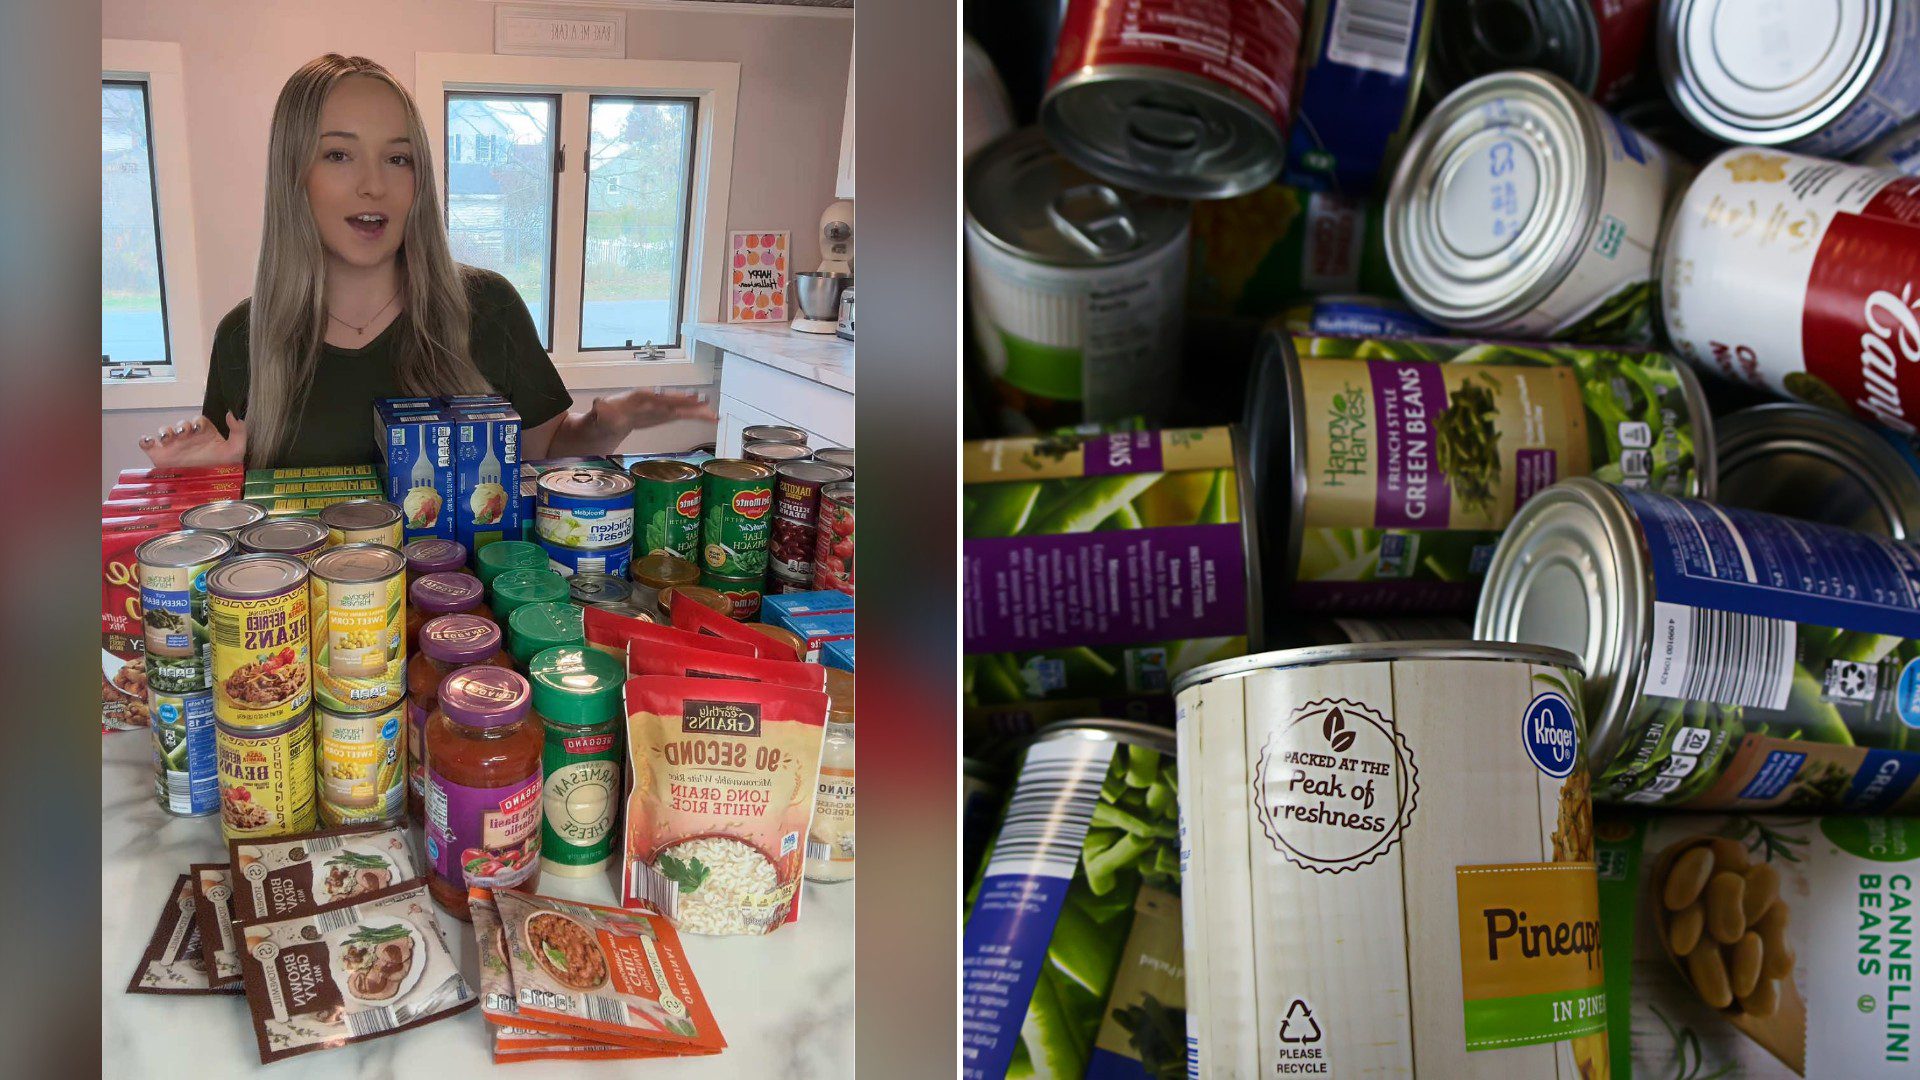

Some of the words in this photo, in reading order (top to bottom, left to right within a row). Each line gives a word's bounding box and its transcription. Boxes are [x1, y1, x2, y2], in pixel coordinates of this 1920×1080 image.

[1488, 141, 1515, 178] CS
[1383, 387, 1400, 426] STYLE
[1397, 367, 1427, 434] BEANS
[1322, 408, 1347, 487] Happy
[1344, 381, 1368, 476] Harvest
[1387, 428, 1402, 491] FRENCH
[1404, 438, 1428, 520] GREEN
[1534, 707, 1574, 763] Kroger
[1648, 721, 1665, 747] NET
[1690, 731, 1707, 750] 20
[1283, 750, 1337, 770] PACKED
[1340, 757, 1359, 771] AT
[1360, 760, 1391, 777] THE
[1288, 769, 1347, 801] Peak
[1350, 778, 1375, 810] of
[1857, 873, 1882, 976] BEANS
[1885, 874, 1912, 1062] CANNELLINI
[1552, 999, 1573, 1023] IN
[1276, 1062, 1328, 1075] RECYCLE
[1279, 1048, 1323, 1060] PLEASE
